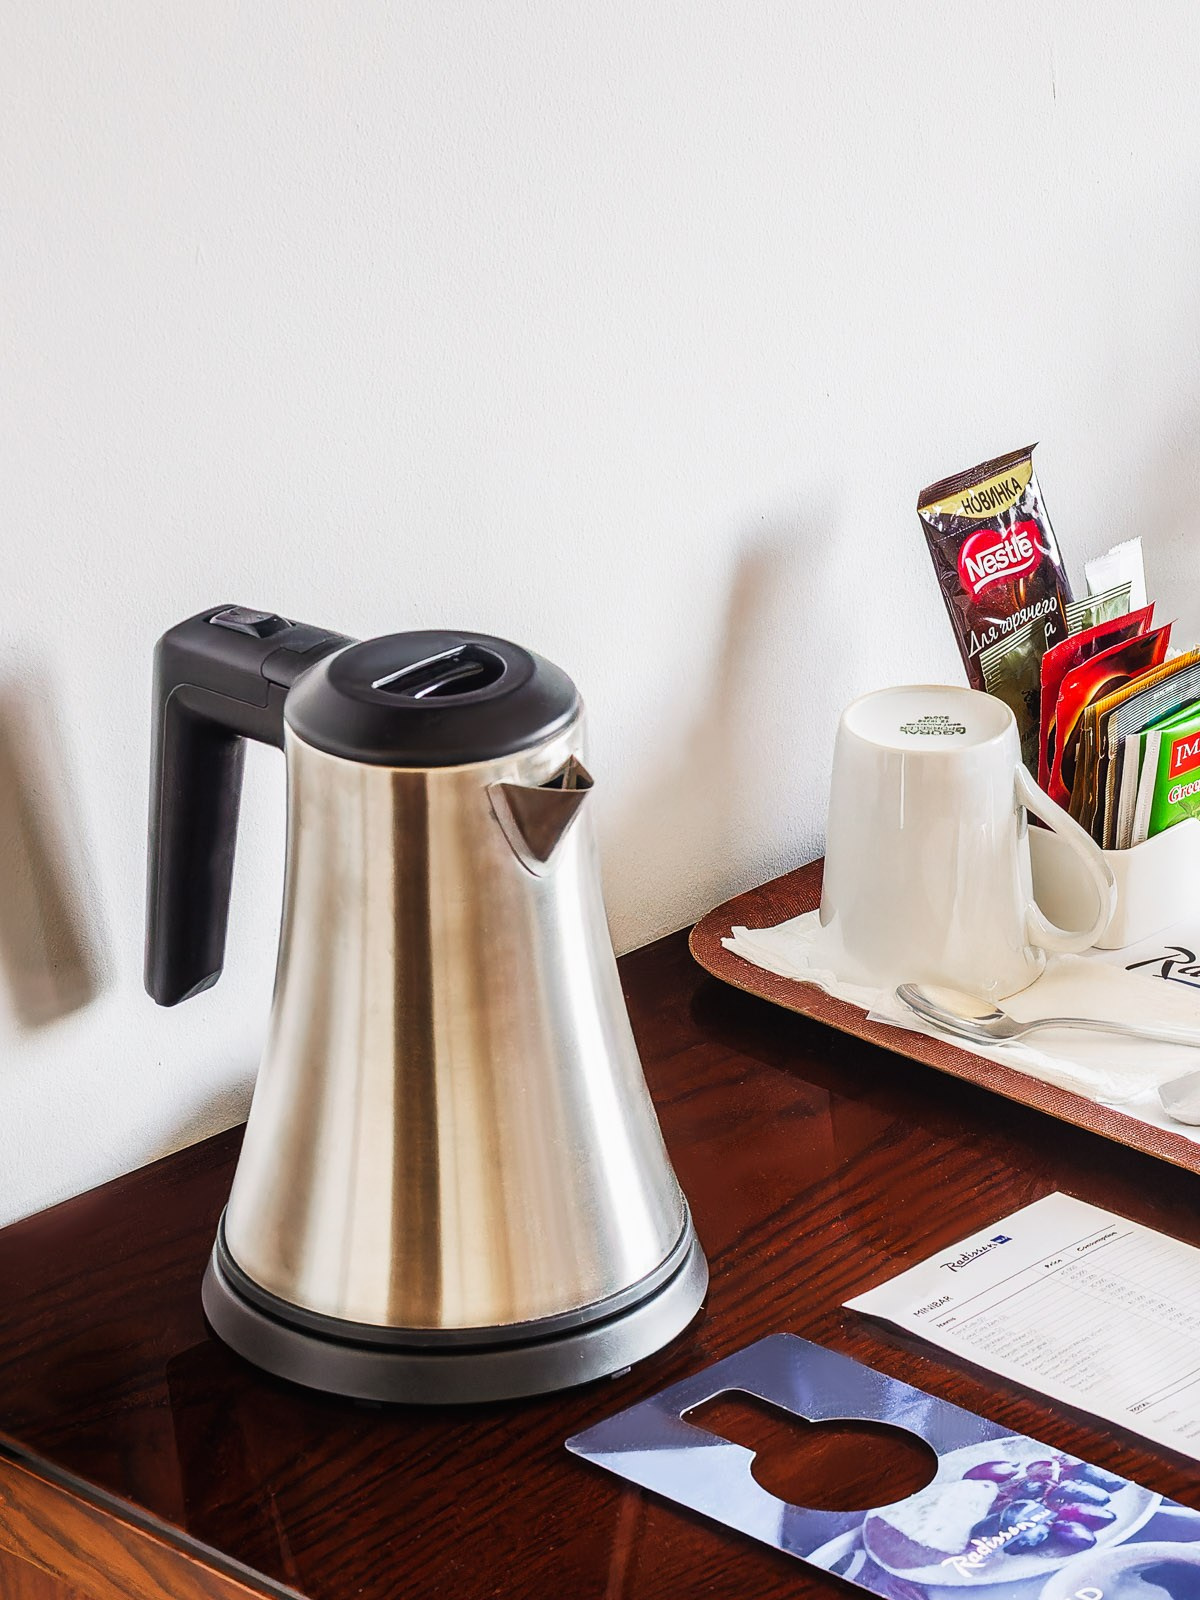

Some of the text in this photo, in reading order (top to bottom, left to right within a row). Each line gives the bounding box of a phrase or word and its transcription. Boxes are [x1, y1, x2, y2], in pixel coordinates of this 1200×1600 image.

[961, 476, 1023, 515] НОВИНКА
[968, 626, 999, 658] Для
[999, 597, 1057, 636] горячего
[940, 1242, 999, 1273] Radisson
[913, 1294, 954, 1317] MINIBAR
[940, 1516, 1036, 1578] Radisson
